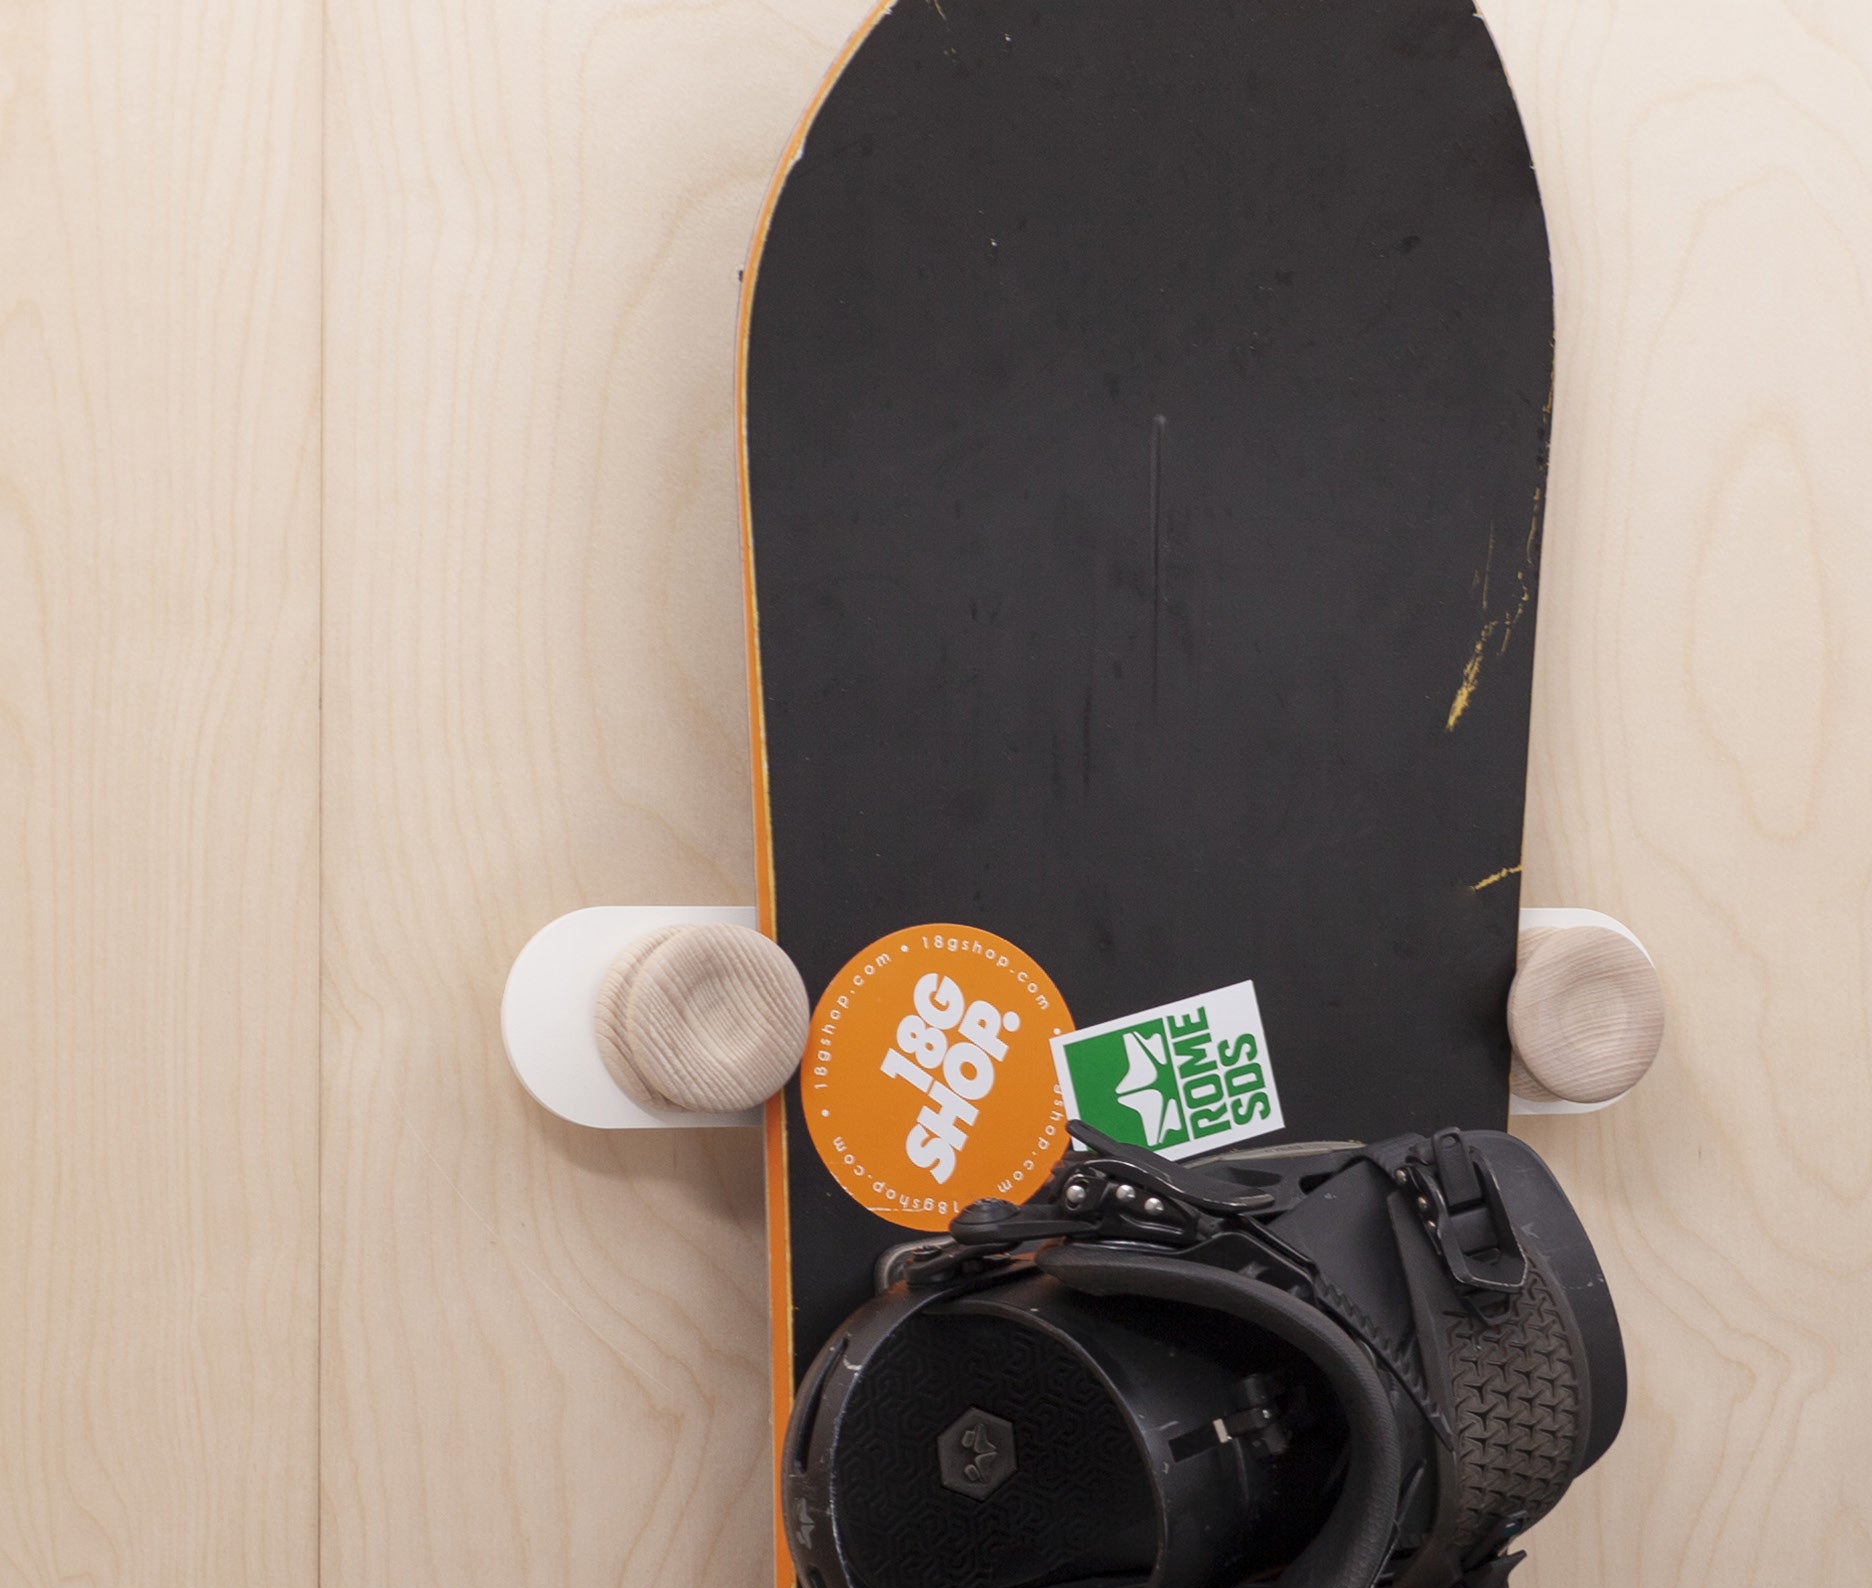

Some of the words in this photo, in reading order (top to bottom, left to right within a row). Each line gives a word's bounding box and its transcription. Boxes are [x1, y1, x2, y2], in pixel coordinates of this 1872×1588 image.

[814, 952, 891, 1089] 18gshop.com
[922, 935, 1049, 1010] 18gshop.com
[880, 972, 965, 1094] 18G
[1166, 1006, 1232, 1140] ROME
[1218, 1031, 1272, 1126] SDS
[905, 1000, 1020, 1184] SHOP.
[997, 1084, 1064, 1193] gshop.com
[833, 1136, 960, 1214] 18gshop.com
